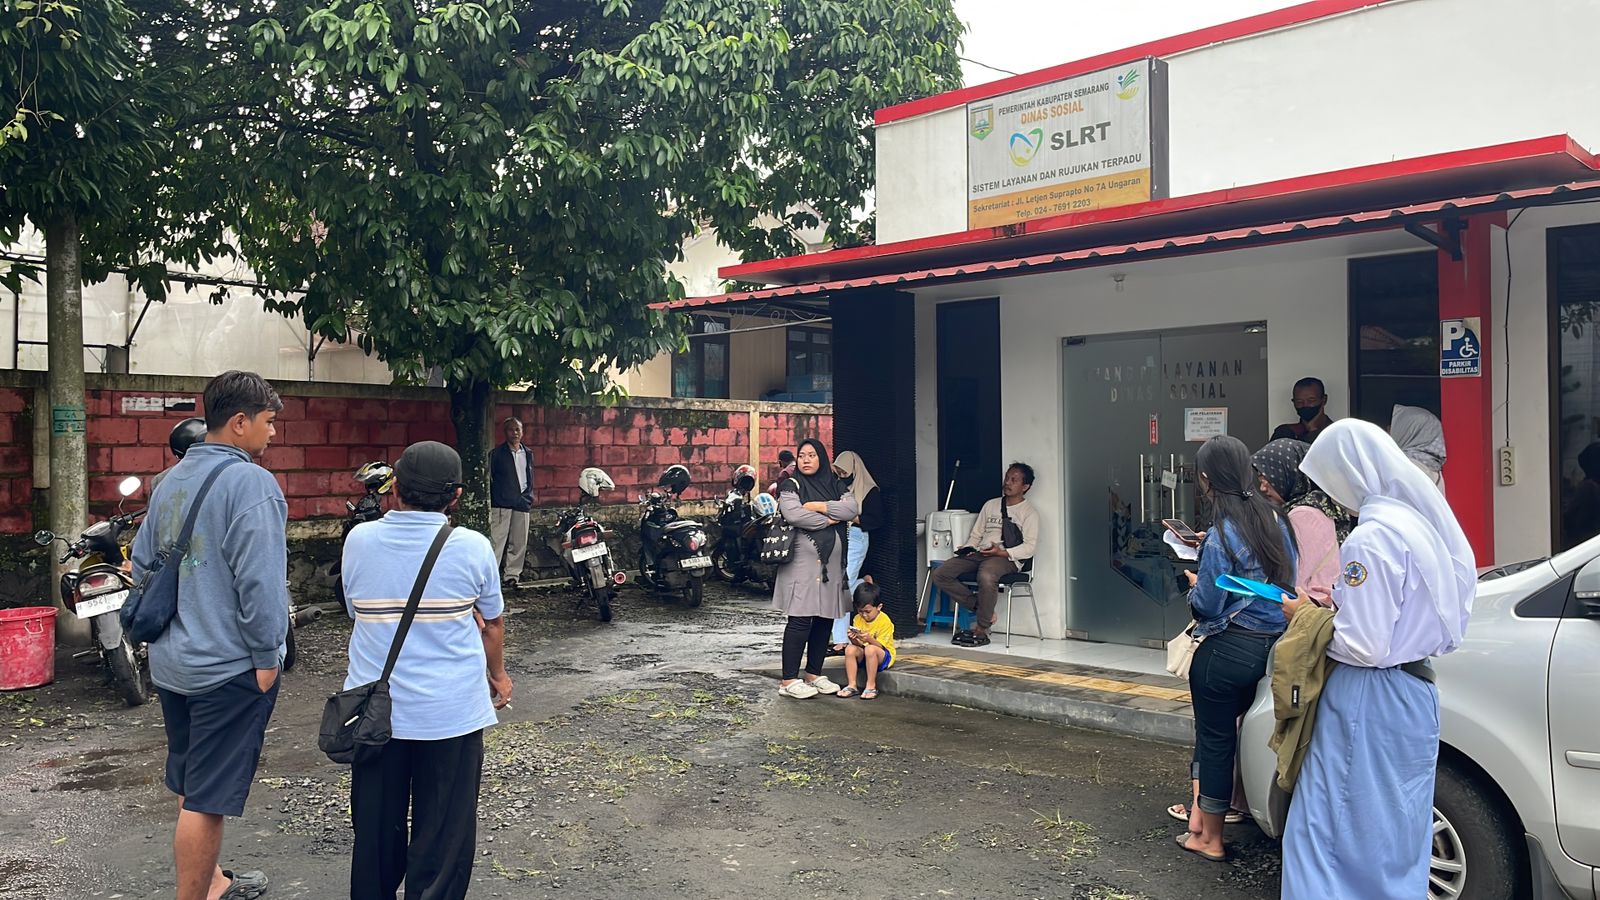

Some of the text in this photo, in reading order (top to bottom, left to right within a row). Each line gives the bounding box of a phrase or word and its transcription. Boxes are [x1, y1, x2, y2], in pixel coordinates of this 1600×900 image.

[998, 82, 1110, 116] PEMERINTAH KABUPATEN SEMARANG
[1021, 100, 1084, 125] DINAS SOSIAL
[1050, 121, 1111, 151] SLRT
[972, 153, 1142, 193] SISTEM LAYANAN DAN RUJUKAN TERPADU
[973, 200, 1010, 213] Sekretariat
[1026, 194, 1048, 205] Letjen
[1049, 187, 1082, 202] Suprapto
[1084, 185, 1094, 193] No
[1096, 181, 1107, 191] 7A
[1108, 177, 1141, 191] Ungaran
[1016, 209, 1033, 219] Telp.
[1034, 206, 1048, 215] 024
[1053, 202, 1071, 212] 7691
[1072, 198, 1091, 208] 2203
[1442, 321, 1465, 351] P
[1442, 367, 1478, 375] DISABILITAS
[1110, 382, 1226, 403] DNAS SOSIAL
